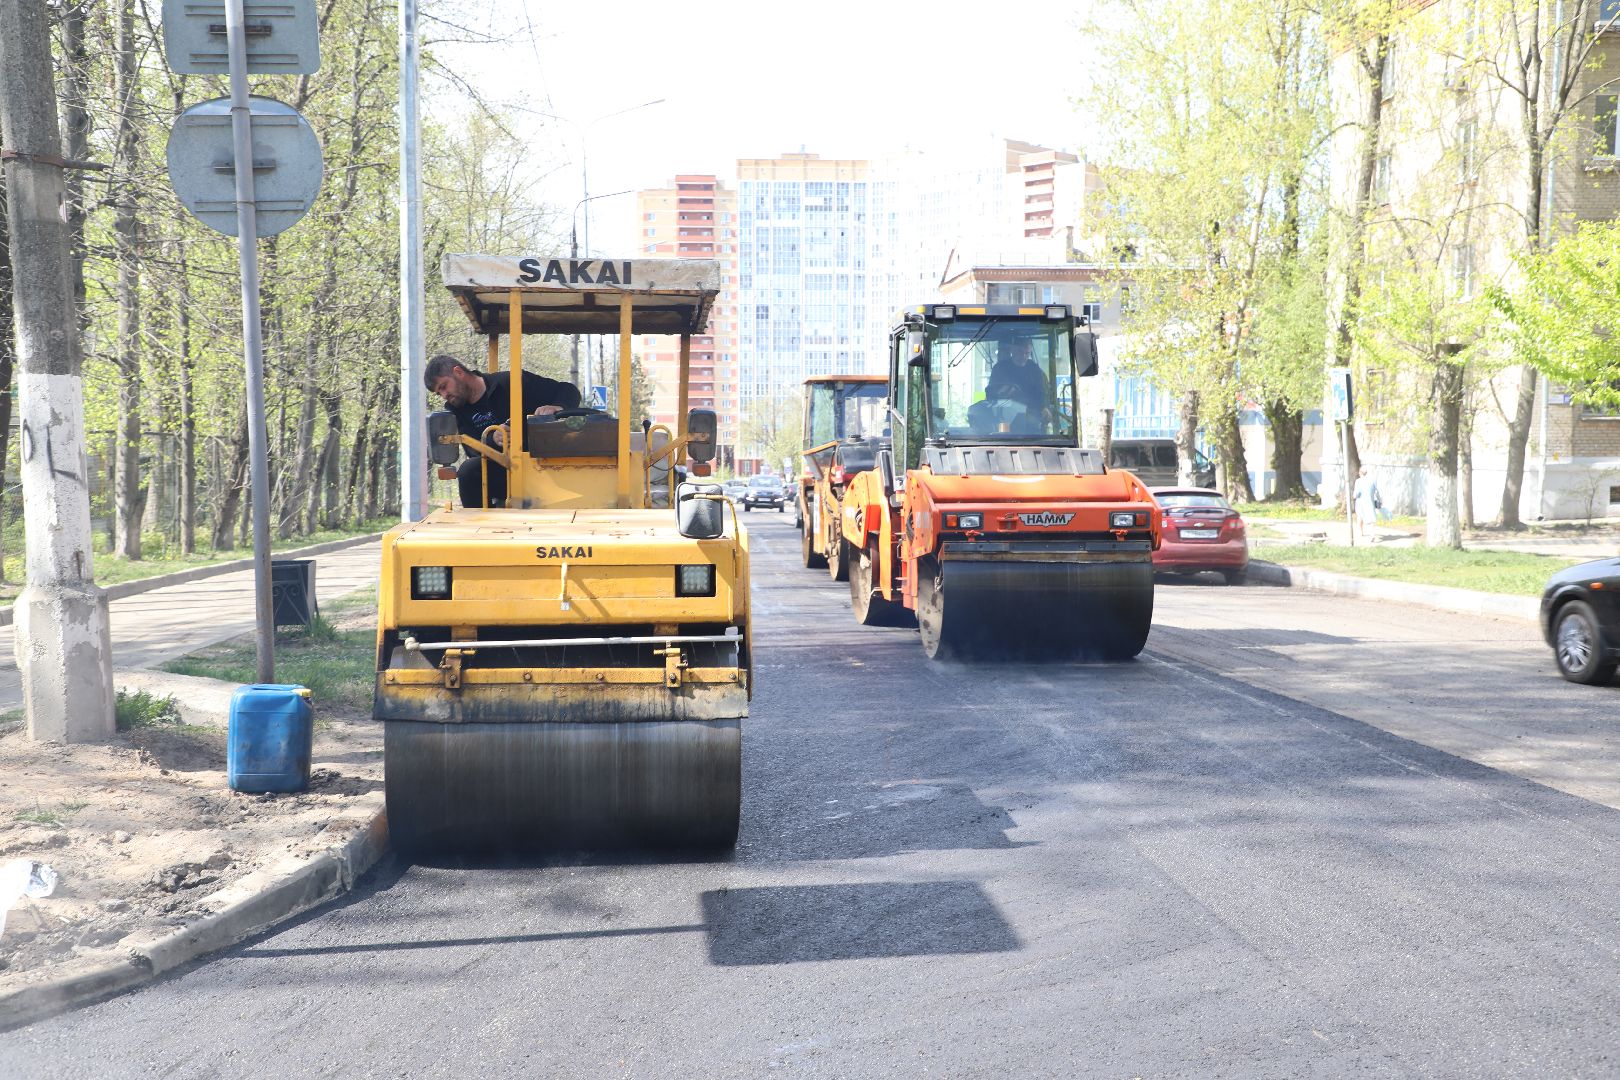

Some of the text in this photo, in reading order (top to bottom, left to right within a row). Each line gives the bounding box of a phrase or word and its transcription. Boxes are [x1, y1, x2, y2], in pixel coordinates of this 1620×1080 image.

[518, 258, 632, 284] SAKAI
[1027, 514, 1066, 524] HAMM
[536, 546, 593, 559] SAKAI
